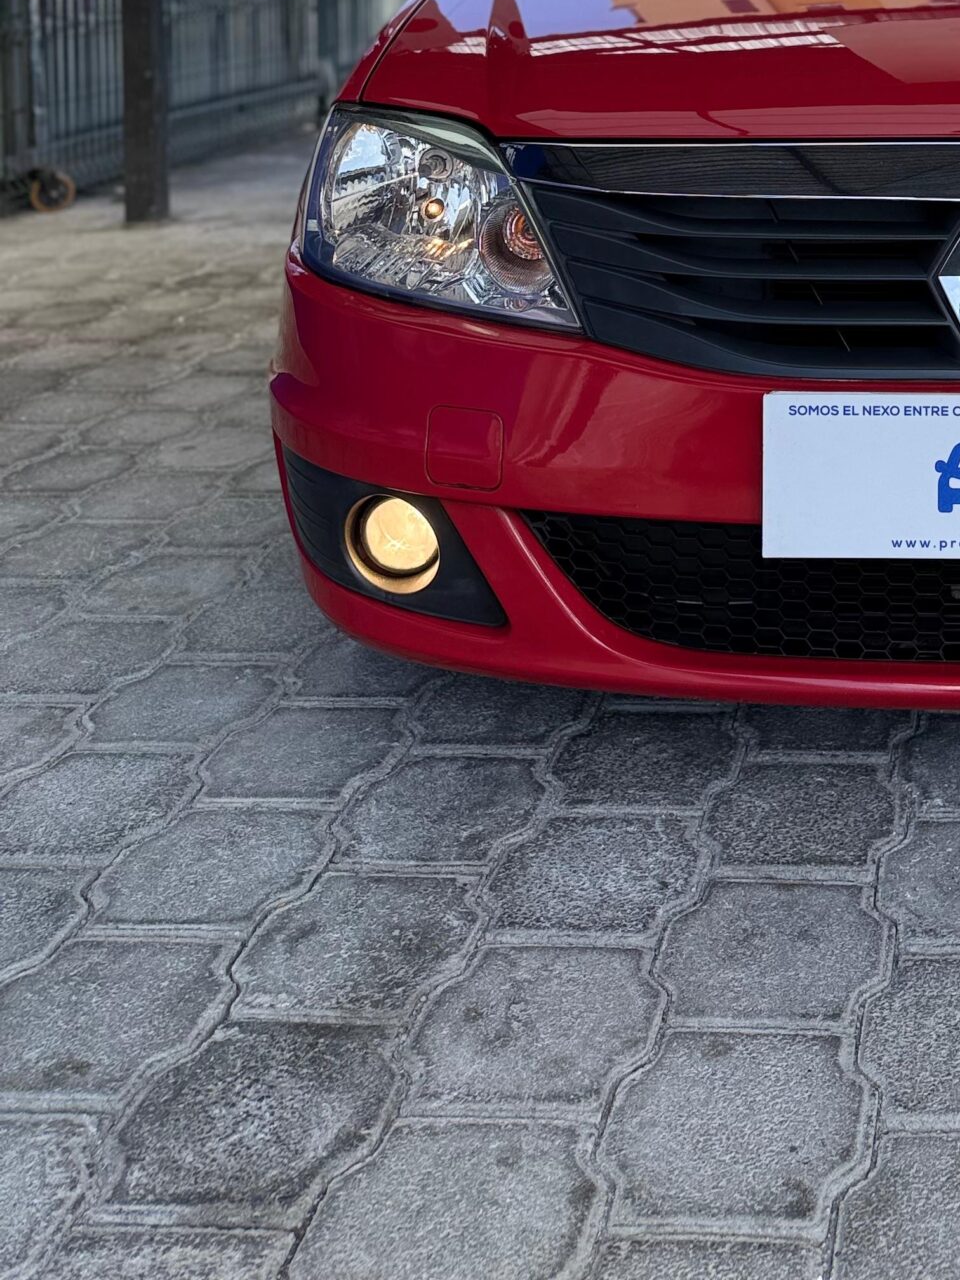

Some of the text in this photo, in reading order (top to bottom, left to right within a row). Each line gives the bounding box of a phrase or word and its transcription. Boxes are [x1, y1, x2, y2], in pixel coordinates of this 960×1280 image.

[788, 405, 840, 417] SOMOS
[842, 405, 860, 417] EL
[862, 405, 901, 417] NEXO
[903, 406, 950, 417] ENTRE
